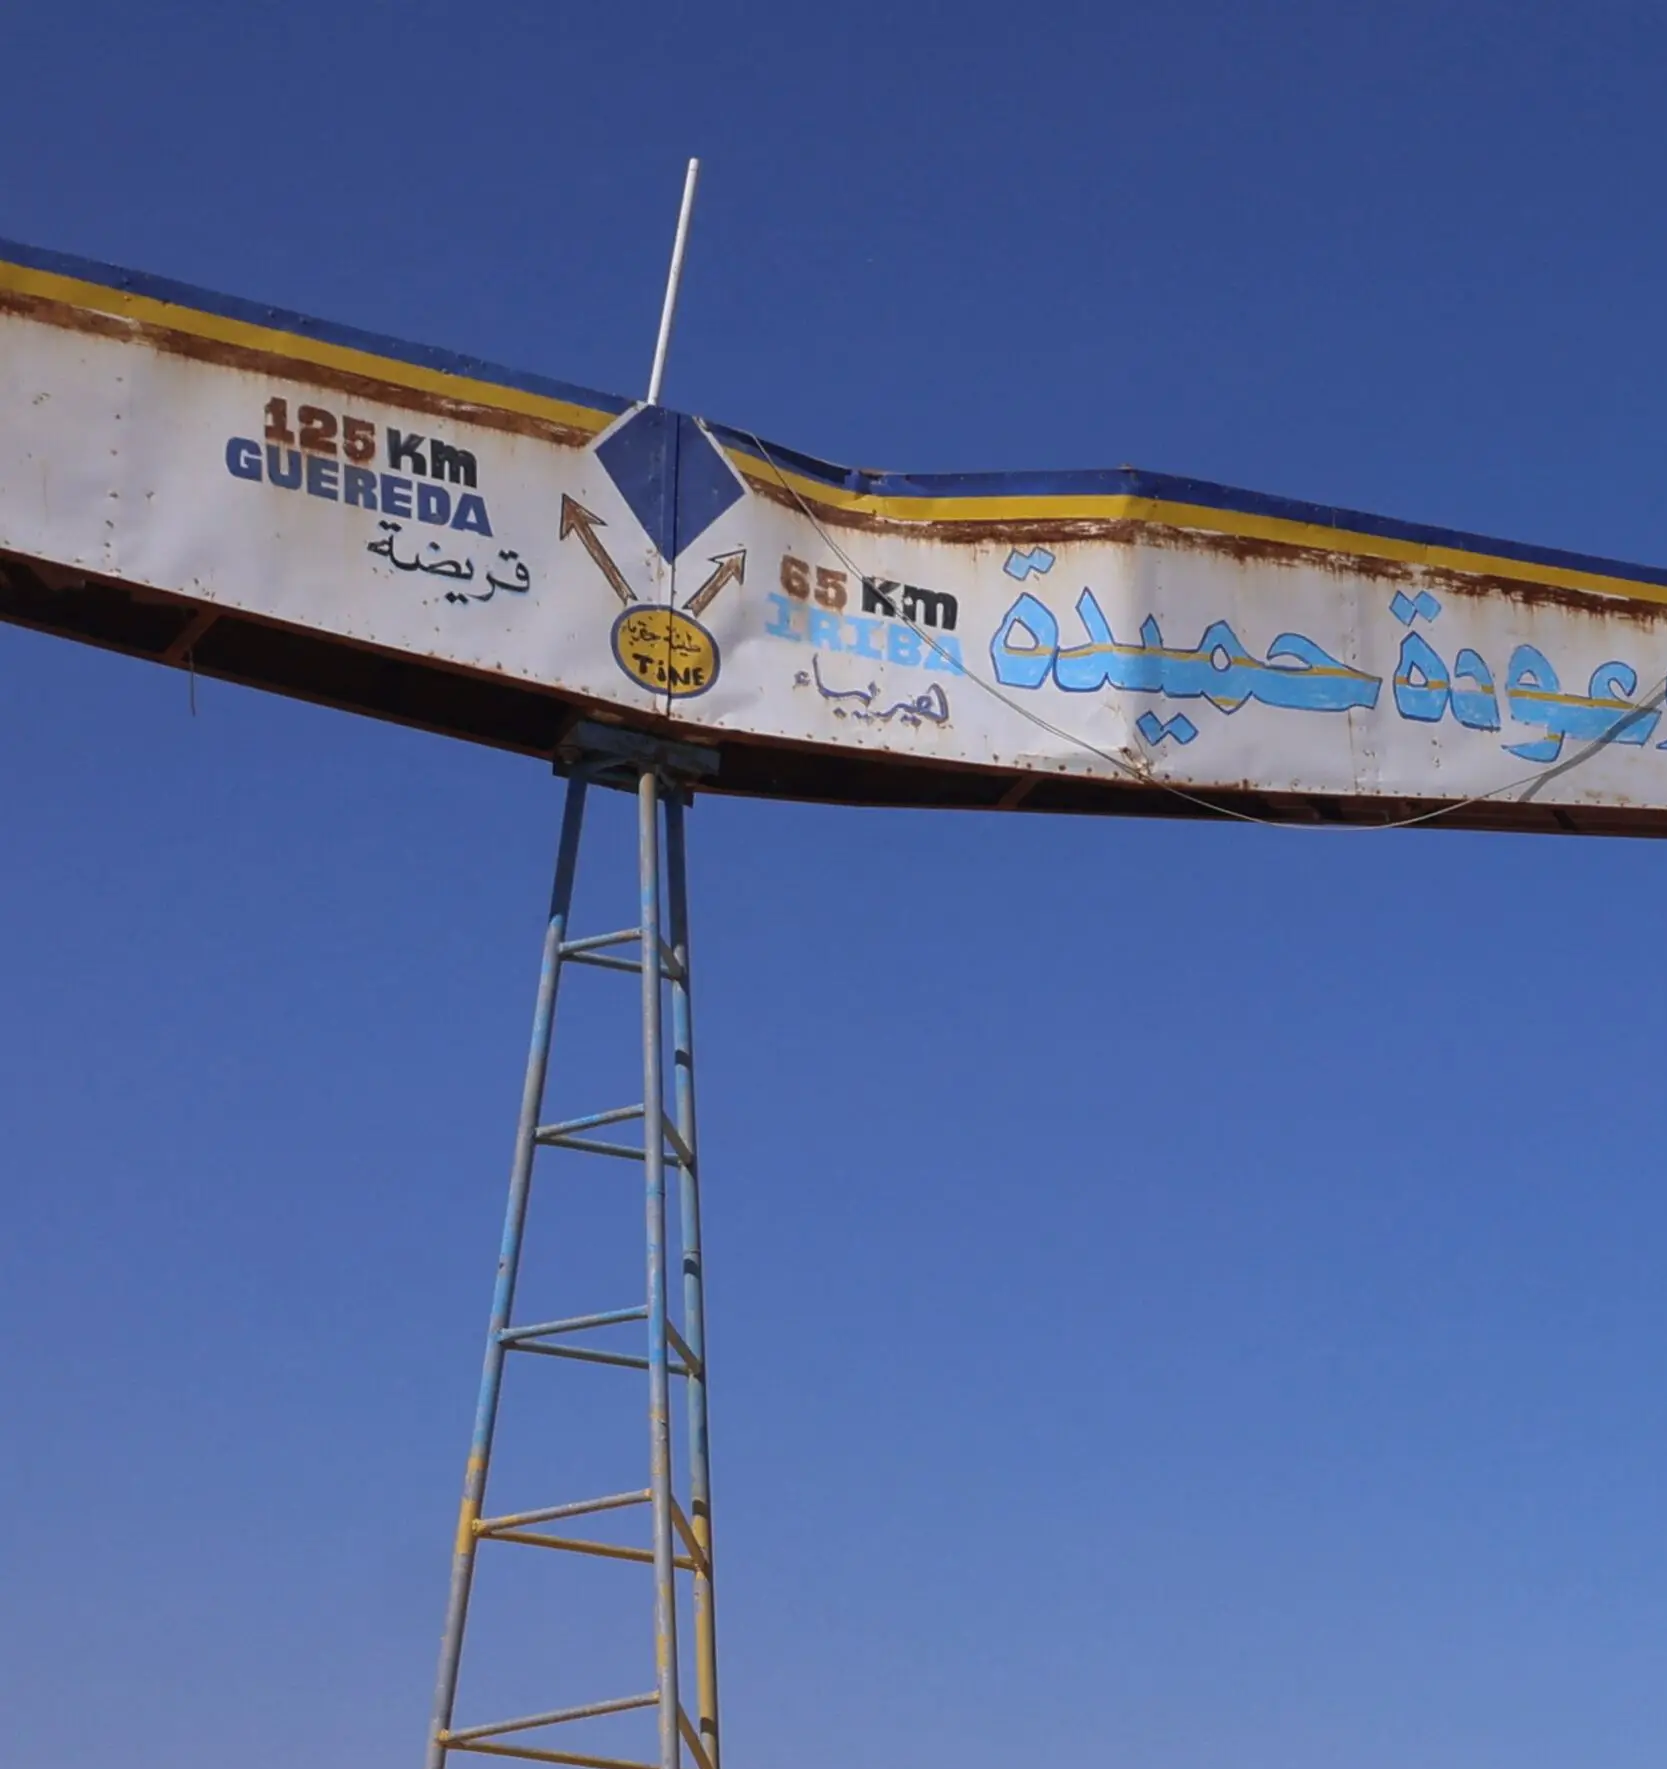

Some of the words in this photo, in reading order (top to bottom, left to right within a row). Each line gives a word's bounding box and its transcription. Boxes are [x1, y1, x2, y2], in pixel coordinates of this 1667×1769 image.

[225, 436, 494, 537] GUEREDA
[264, 396, 376, 462] 125
[386, 427, 478, 489] Km
[366, 519, 531, 603] قريضة
[780, 553, 848, 611] 65
[861, 575, 959, 631] Km
[765, 591, 967, 677] IRIBA
[990, 545, 1384, 746] حميدة
